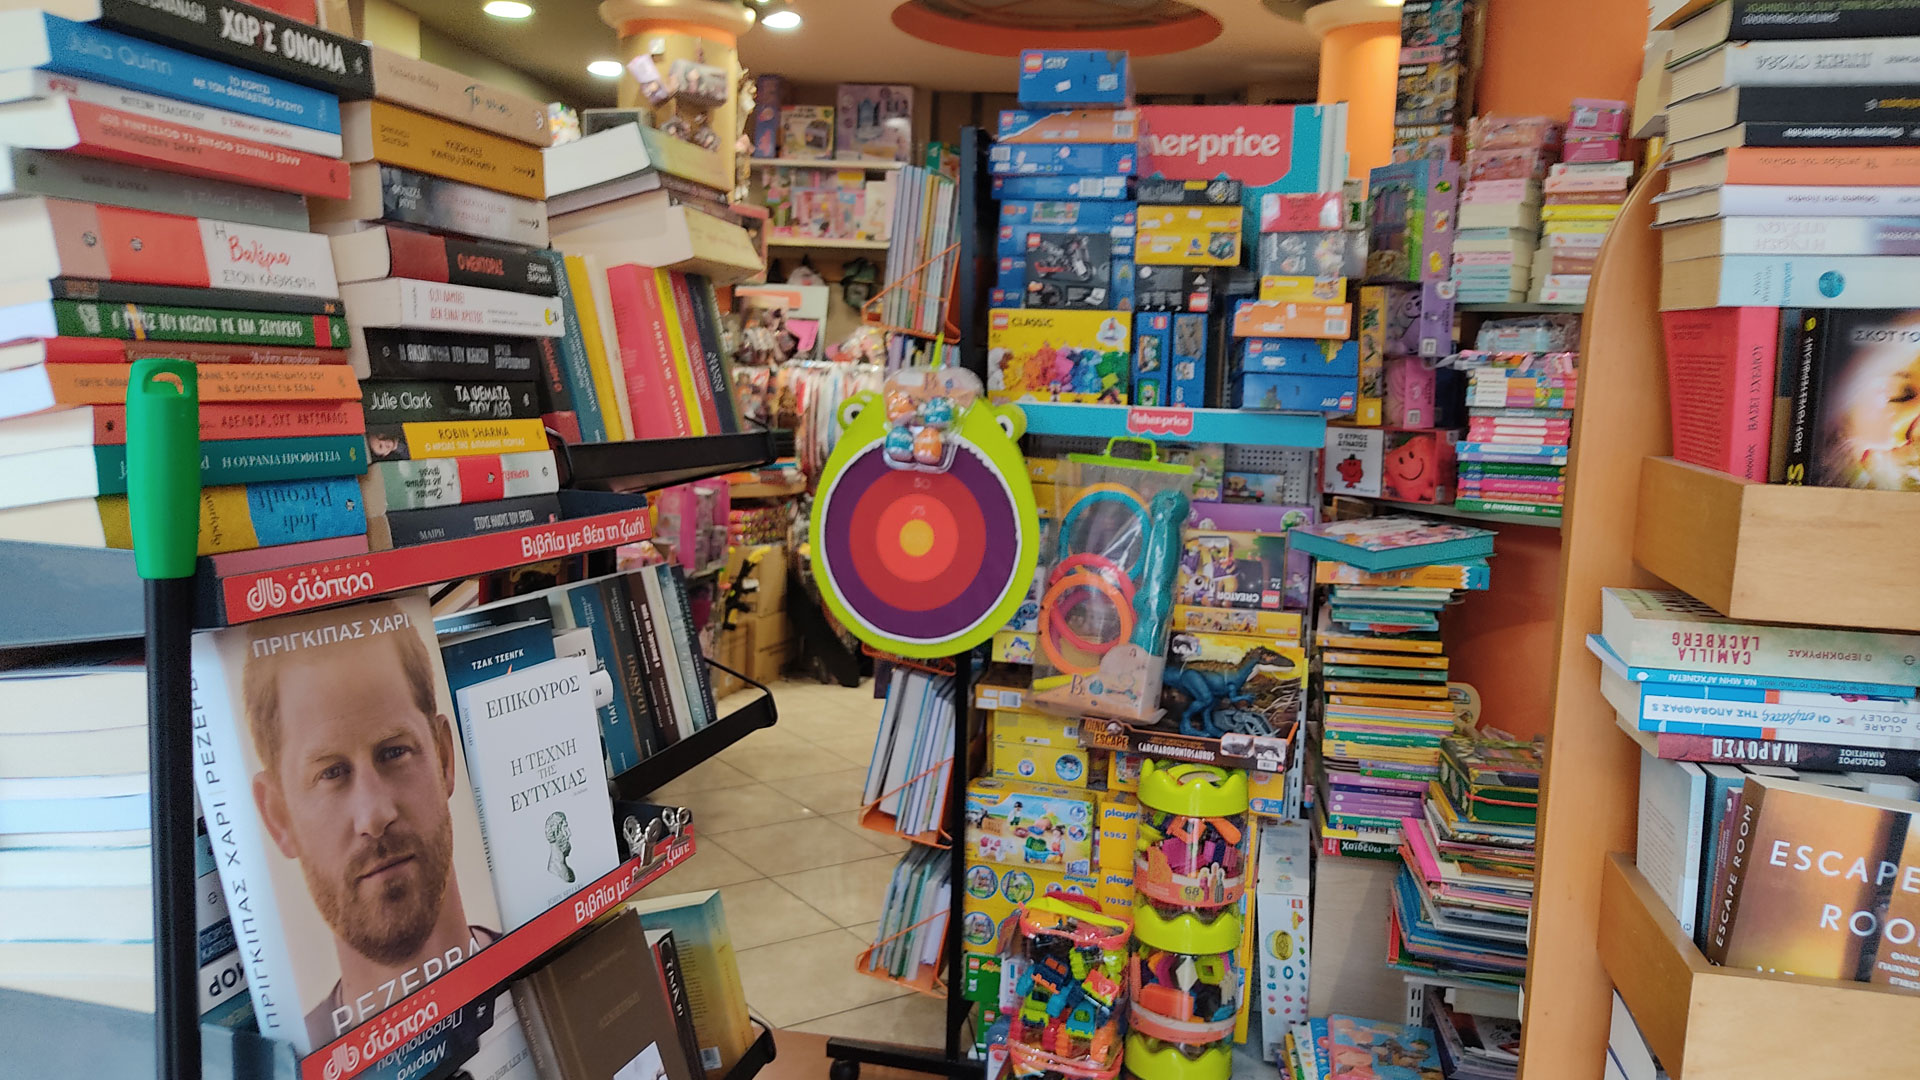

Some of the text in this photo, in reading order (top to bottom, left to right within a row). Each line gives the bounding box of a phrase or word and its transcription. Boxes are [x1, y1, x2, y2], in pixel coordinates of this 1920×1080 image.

[283, 23, 348, 75] ΟΝΟΜΑ
[118, 46, 173, 77] Quinn
[1011, 317, 1054, 328] CLASSIC
[1854, 330, 1899, 342] ΣΚΟΤ
[371, 391, 433, 411] Julie Clark
[454, 385, 470, 402] ΤΑ
[438, 426, 510, 440] ROBIN SHARMA
[255, 485, 333, 512] Picoult
[282, 512, 319, 534] Jodi
[418, 528, 445, 541] ΜΑΙΡΗ
[520, 517, 646, 557] Βιβλία με θέα τη ζωή!
[290, 571, 375, 604] διόπτρα
[1217, 591, 1260, 602] CREATOR
[252, 612, 410, 657] ΠΡΙΓΚΙΠΑΣ ΧΑΡΙ
[471, 649, 525, 671] ΤΖΑΚ ΤΣΕΝΓΚ
[1678, 647, 1751, 665] CAMILLA
[1787, 649, 1862, 661] ΙΕΡΟΚΗΡΥΚΑΣ
[626, 654, 647, 715] ΙΩΑΝΝΗ
[1668, 674, 1757, 686] ΝΑ ΜΗΝ ΑΓΧΩΝΕΤΑΙ
[485, 674, 580, 720] ΕΠΙΚΟΥΡΟΣ
[1663, 703, 1734, 717] ΑΠΟΒΑΘΡΑΣ
[1736, 708, 1759, 719] ΤΗΣ
[1818, 715, 1831, 723] ΟΙ
[1861, 714, 1908, 724] POOLEY
[1864, 723, 1902, 733] CLARE
[1093, 732, 1129, 748] ESCAPE
[1711, 738, 1799, 763] ΜΑΡΟΥΣΩ
[509, 738, 578, 777] Η ΤΕΧΝΗ
[1138, 742, 1216, 762] CARCHARODONTOSAURUS
[1838, 756, 1887, 767] ΘΕΟΔΩΡΟΣ
[537, 764, 558, 780] ΤΗΣ
[510, 767, 588, 813] ΕΥΤΥΧΙΑΣ
[1715, 873, 1738, 948] ESCAPE
[1734, 805, 1754, 868] ROOM
[1769, 840, 1920, 894] ESCAPE
[574, 877, 632, 923] Βιβλία με
[1184, 885, 1200, 896] 68
[213, 802, 280, 1029] ΠΡΙΓΚΙΠΑΣ ΧΑΡΙ
[1820, 903, 1920, 945] ROO
[363, 1001, 440, 1060] διόπτρα
[376, 1007, 464, 1071] Πετροπούλου
[396, 1040, 448, 1080] Μαρίνα
